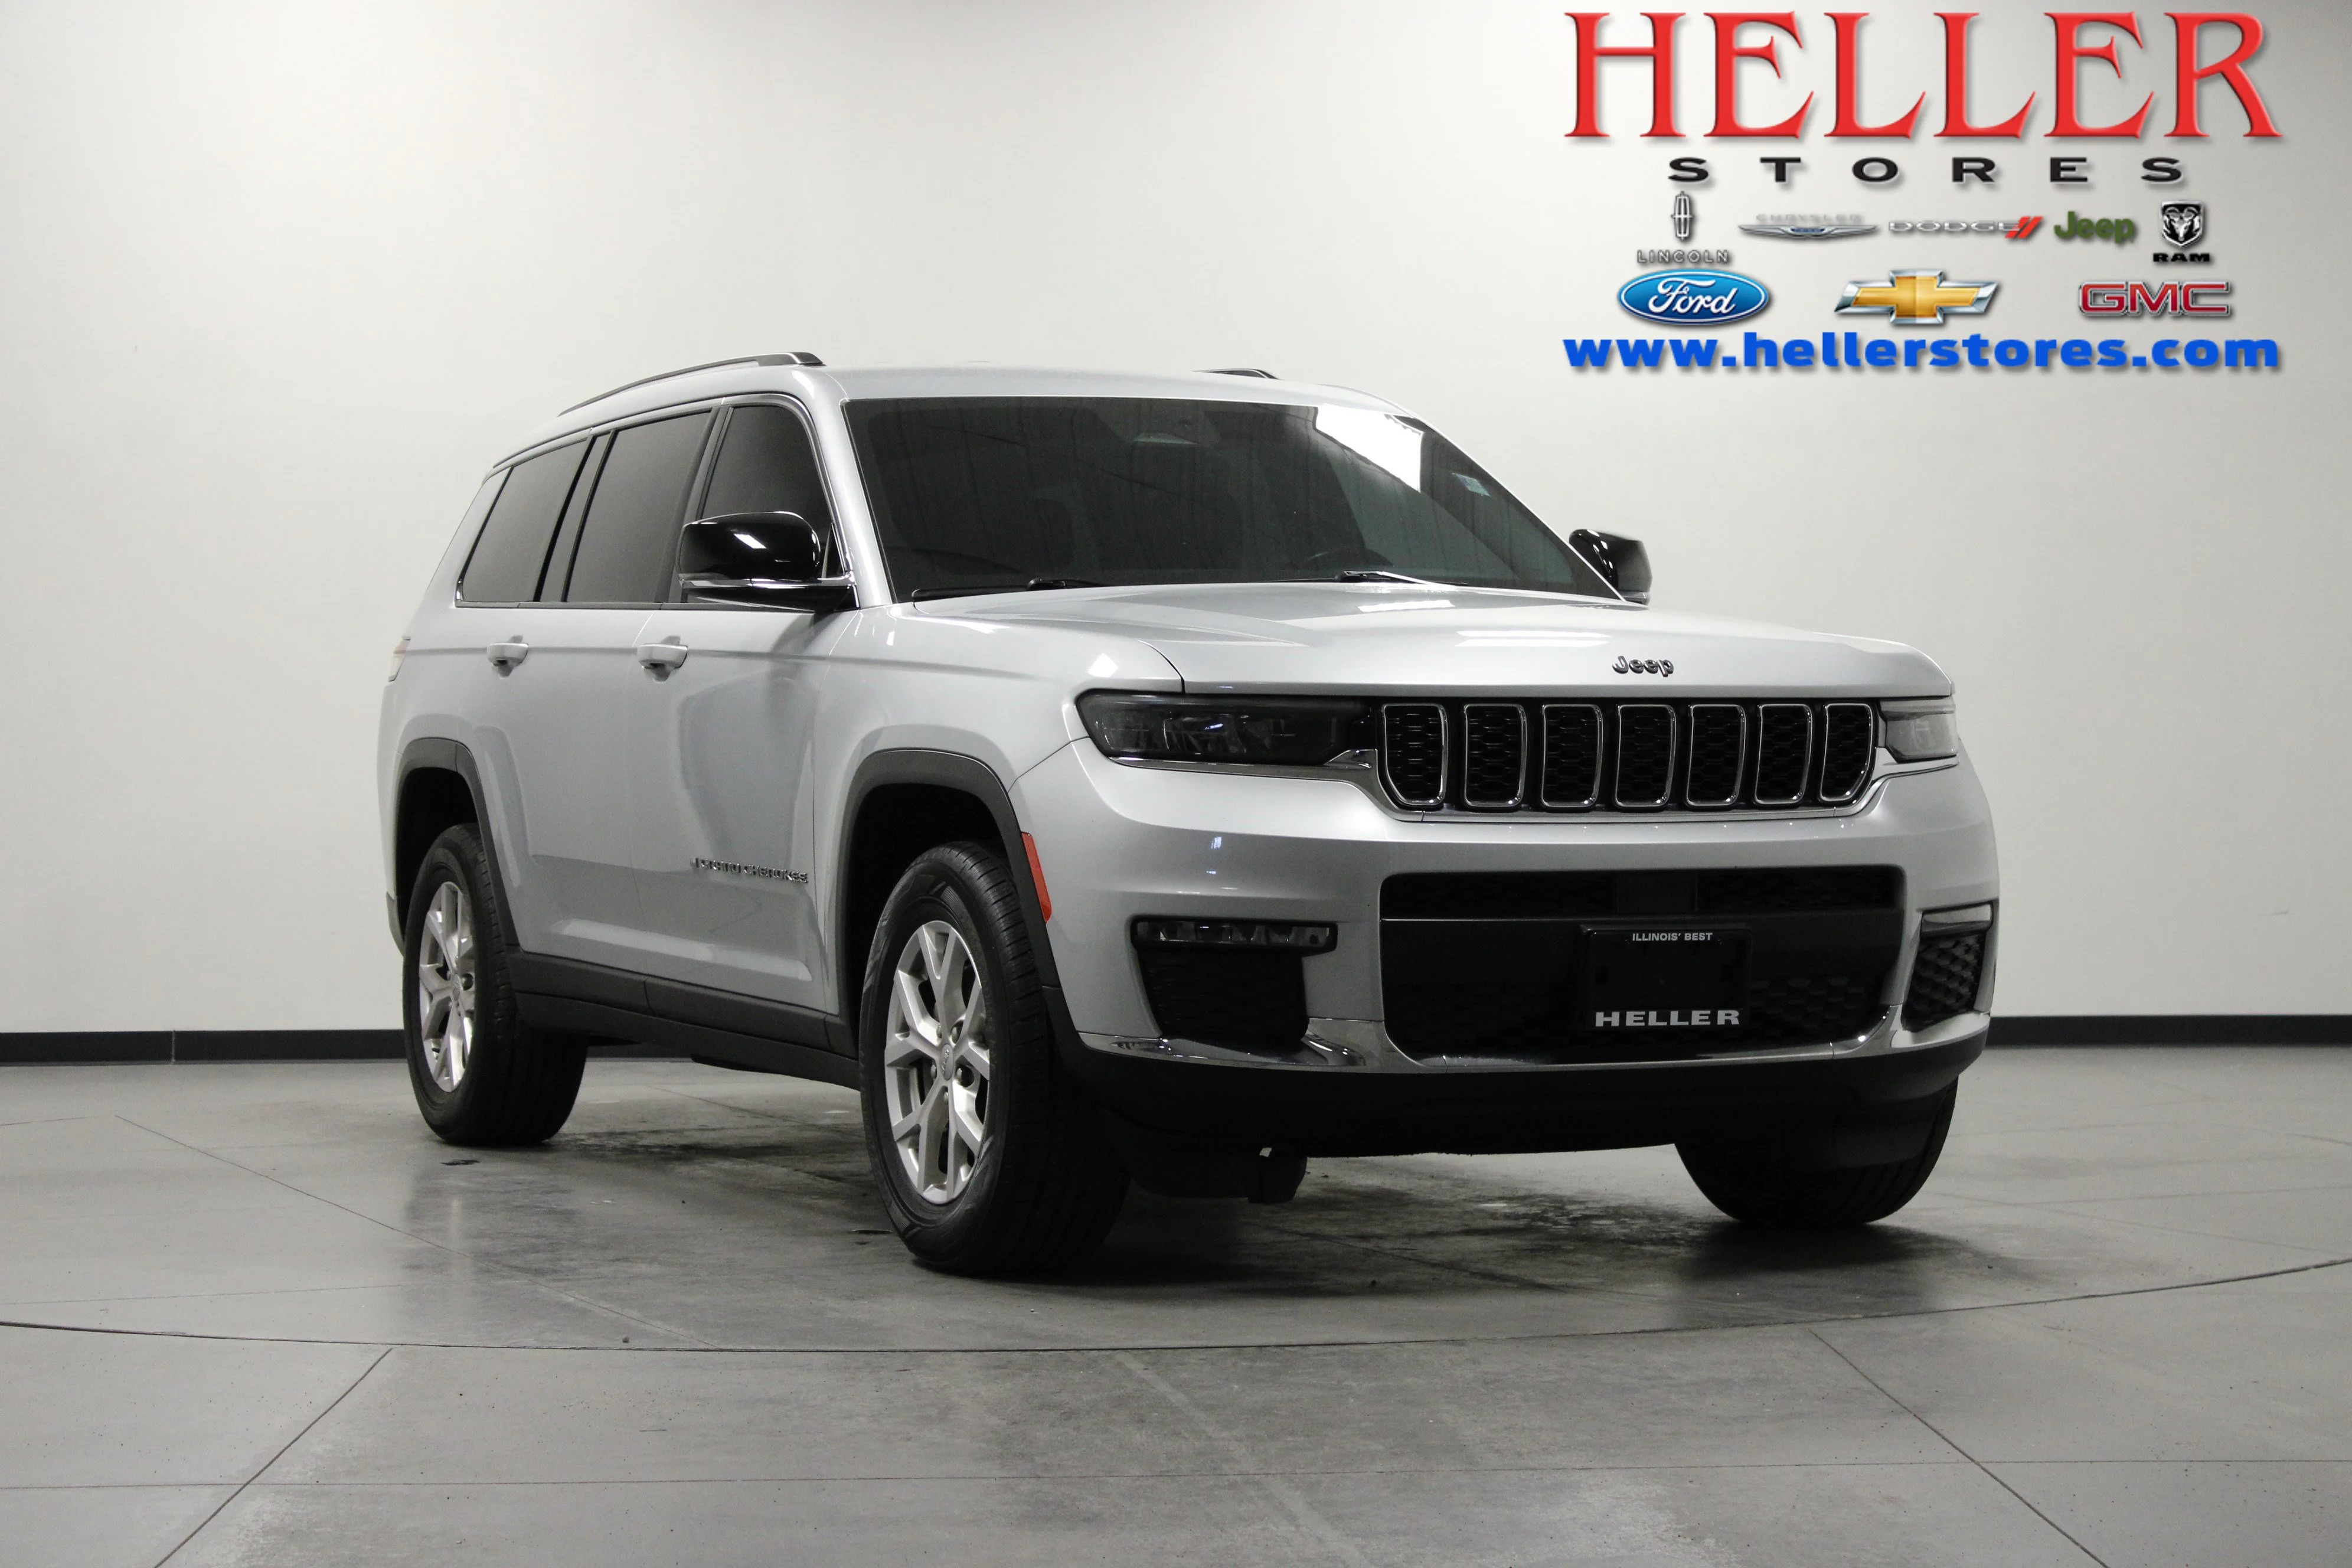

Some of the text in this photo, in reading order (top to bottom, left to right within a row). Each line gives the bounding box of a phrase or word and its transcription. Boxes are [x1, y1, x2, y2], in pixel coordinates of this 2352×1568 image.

[1612, 655, 1674, 678] Jeep
[1632, 932, 1713, 942] ILLINOIS' BEST
[1595, 1010, 1740, 1027] HELLER
